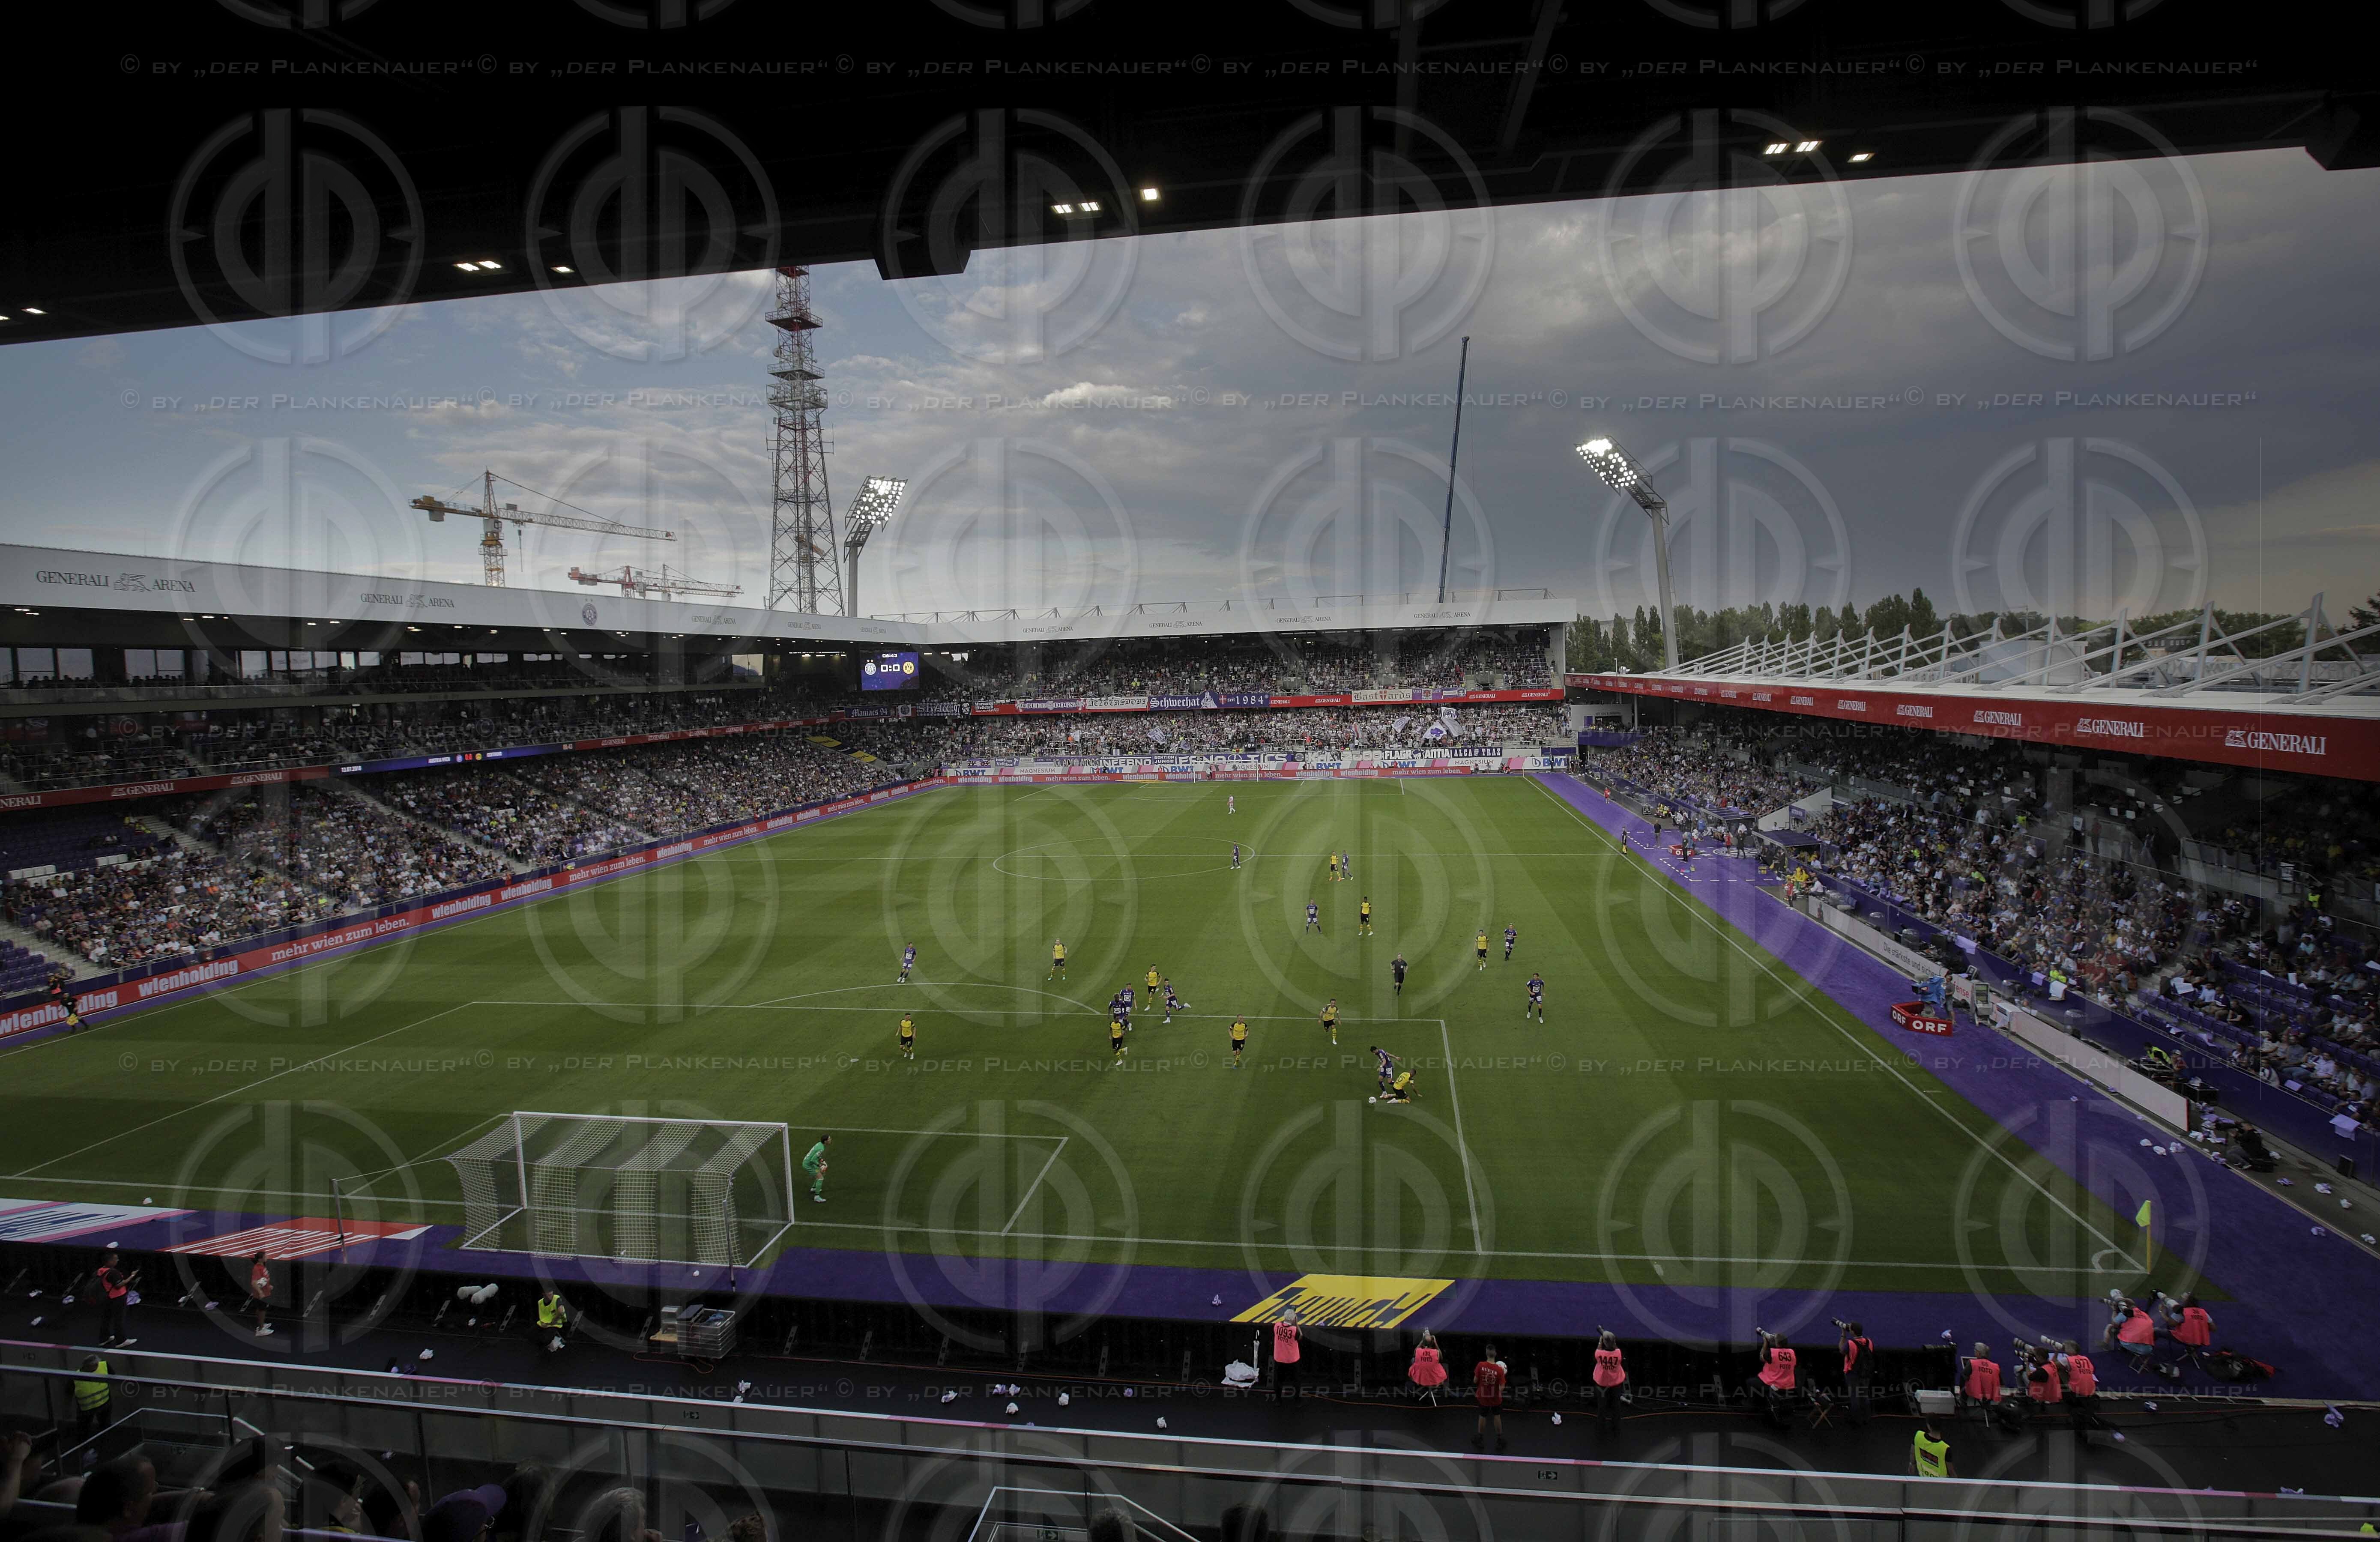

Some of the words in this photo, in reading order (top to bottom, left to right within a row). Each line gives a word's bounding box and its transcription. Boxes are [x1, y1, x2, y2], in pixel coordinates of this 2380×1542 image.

[36, 570, 110, 586] GENERALI
[152, 579, 195, 591] ARENA
[361, 593, 402, 604] GENERALI
[428, 597, 454, 607] ARENA
[880, 663, 900, 672] 0:0
[1150, 696, 1200, 708] Schwechat
[1236, 695, 1264, 703] 1984
[1796, 696, 1813, 705] GENERALI
[1844, 699, 1866, 711] GENERALI
[1905, 704, 1933, 717] GENERALI
[1984, 710, 2021, 725] GENERALI
[2092, 718, 2144, 736] GENERALI
[2248, 731, 2327, 754] GENERALI
[243, 771, 282, 782] GENERALI
[126, 782, 174, 794] GENERALI
[704, 836, 718, 844] mehr
[744, 825, 758, 834] leben.
[569, 869, 589, 880] mehr
[591, 864, 608, 875] wien
[626, 855, 645, 865] leben.
[272, 942, 308, 960] mehr
[311, 934, 343, 949] wien
[346, 927, 372, 940] zum
[376, 917, 410, 932] leben.
[1892, 948, 1910, 964] stärkste
[1911, 959, 1920, 970] und
[1893, 1009, 1906, 1024] ORF
[1912, 1019, 1947, 1032] ORF
[1277, 1325, 1293, 1339] 1093
[1277, 1335, 1289, 1343] FOTO
[1599, 1355, 1618, 1366] 1447
[1779, 1351, 1791, 1362] 643
[1978, 1366, 1993, 1375] FOTO
